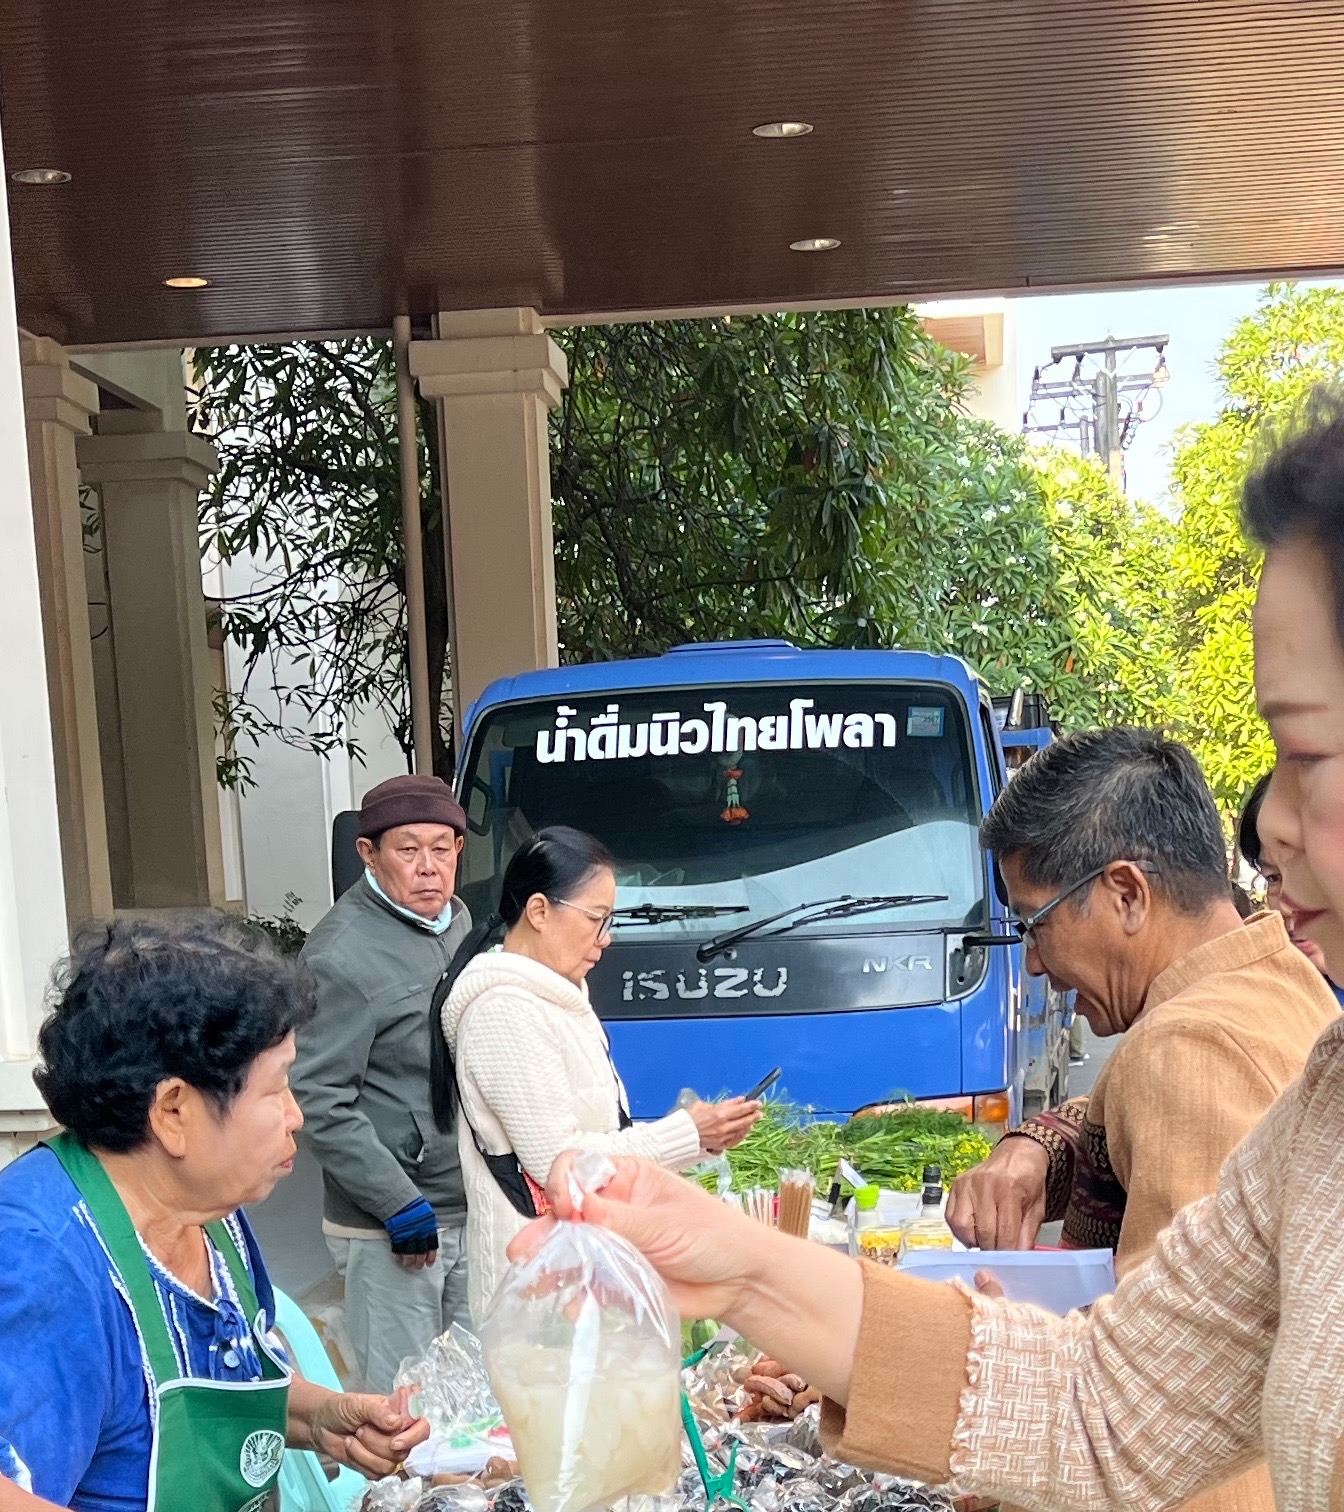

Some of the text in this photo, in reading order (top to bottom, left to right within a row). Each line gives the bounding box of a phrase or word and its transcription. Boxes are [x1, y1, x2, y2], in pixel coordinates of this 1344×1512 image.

[536, 698, 896, 764] น้ำดื่มนิวไทยโพลา
[862, 955, 933, 974] NKR
[622, 966, 788, 1001] ISUZU
